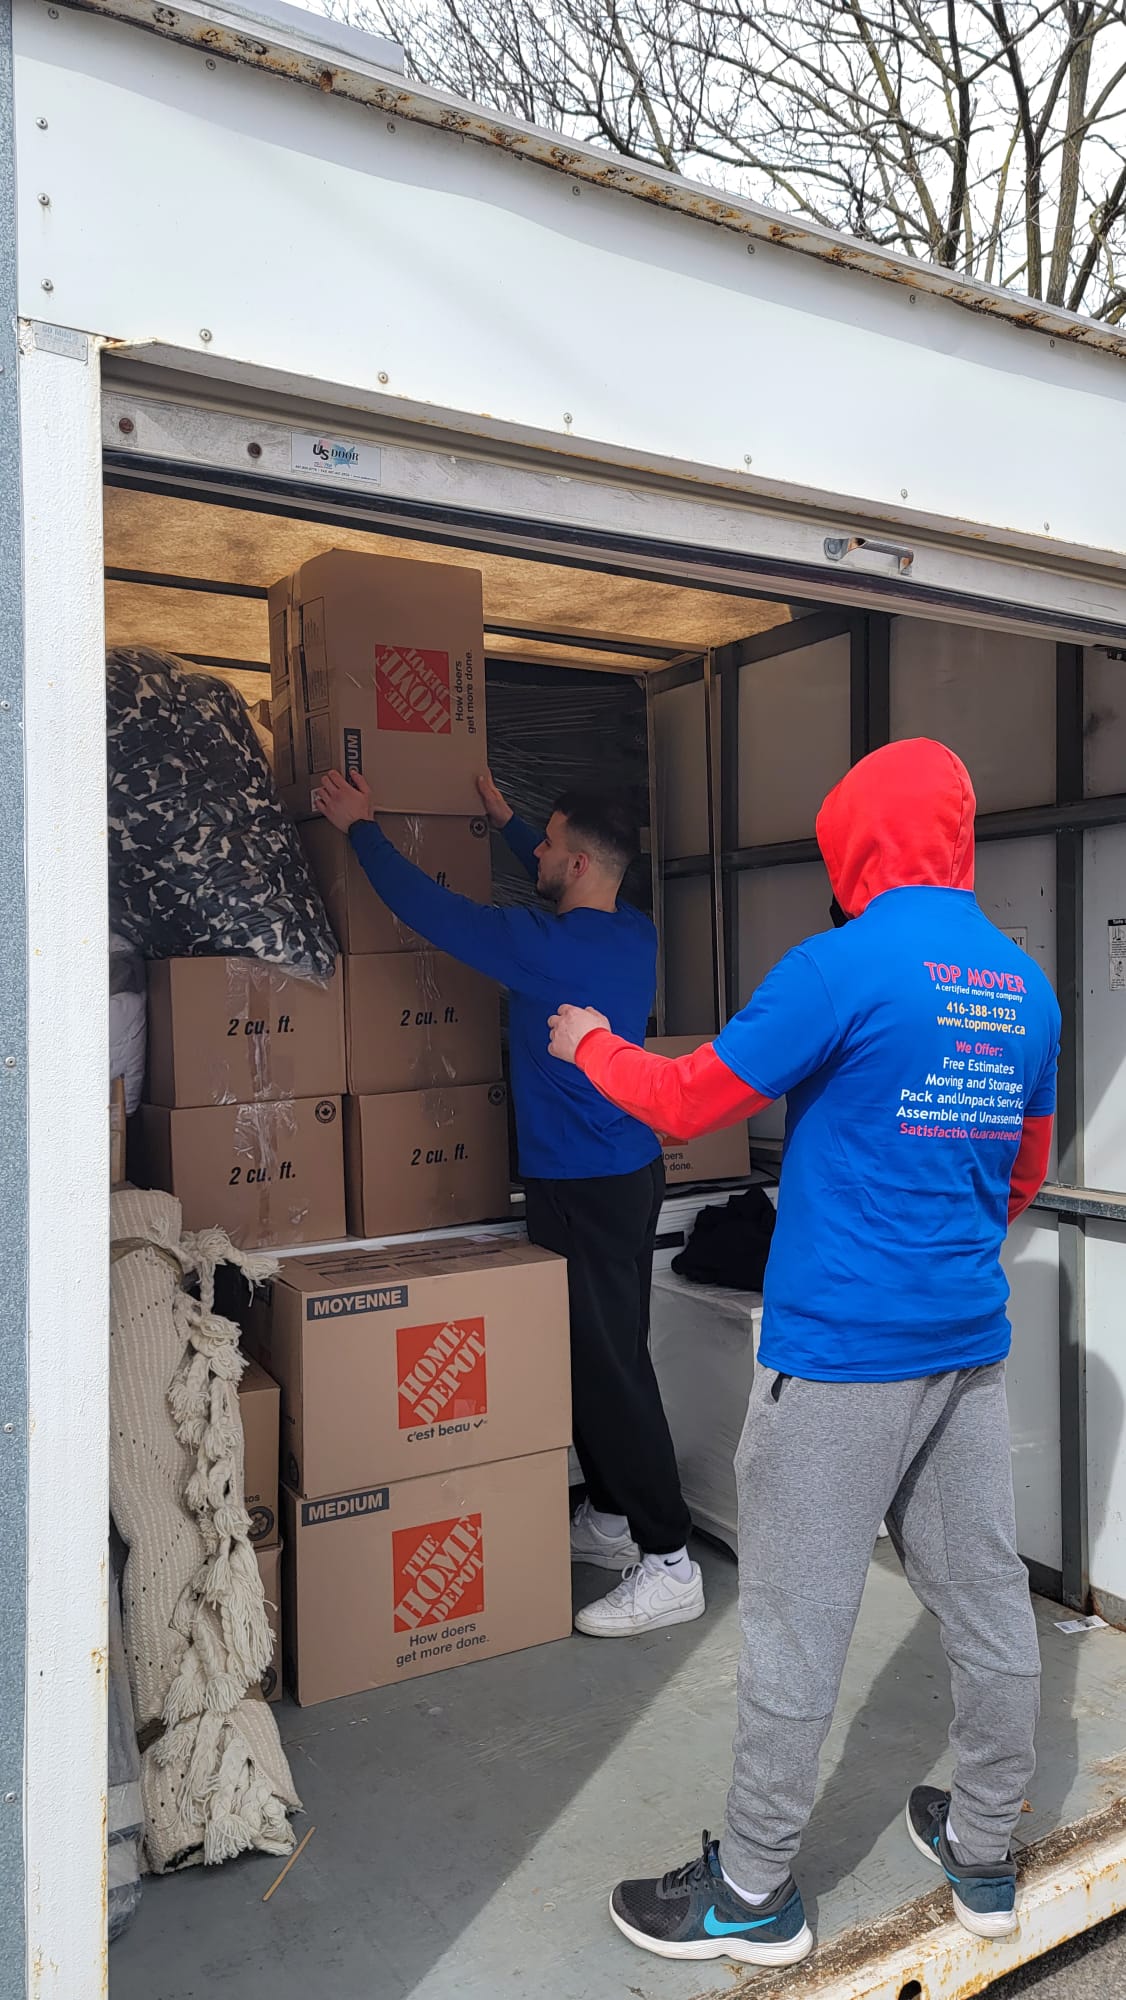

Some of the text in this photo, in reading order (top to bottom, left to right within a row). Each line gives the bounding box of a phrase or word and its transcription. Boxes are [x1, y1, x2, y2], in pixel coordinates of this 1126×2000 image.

[312, 444, 359, 461] US DOOR
[403, 648, 451, 701] DEPOT
[375, 646, 451, 734] HOME
[455, 660, 464, 722] How doers
[465, 649, 477, 734] get more done.
[384, 687, 415, 724] THE
[923, 961, 1028, 994] TOP MOVER
[941, 984, 970, 994] certified
[971, 989, 995, 1000] moving
[996, 992, 1023, 1004] company
[400, 1006, 459, 1027] 2 cu. ft.
[946, 1001, 1017, 1021] 416-388-1923
[227, 1015, 294, 1036] 2 cu. ft.
[936, 1016, 1026, 1036] www.topmover.ca
[956, 1040, 1004, 1057] We Offer:
[943, 1056, 1015, 1075] Free Estimates
[925, 1073, 1023, 1094] Moving and Storage
[900, 1088, 1024, 1110] Pack and Unpack Servic
[896, 1105, 959, 1122] Assemble
[900, 1122, 968, 1139] Satisfactio
[410, 1143, 468, 1166] 2 cu. ft.
[228, 1160, 296, 1186] 2 cu. ft.
[313, 1289, 402, 1316] MOYENNE
[398, 1320, 466, 1405] HOME
[414, 1330, 486, 1425] DEPOT
[407, 1422, 470, 1442] c'est beau
[308, 1492, 383, 1521] MEDIUM
[402, 1534, 440, 1579] THE
[394, 1516, 482, 1628] HOME
[430, 1551, 484, 1622] DEPOT
[410, 1622, 476, 1648] How doers
[396, 1634, 490, 1668] get more done.
